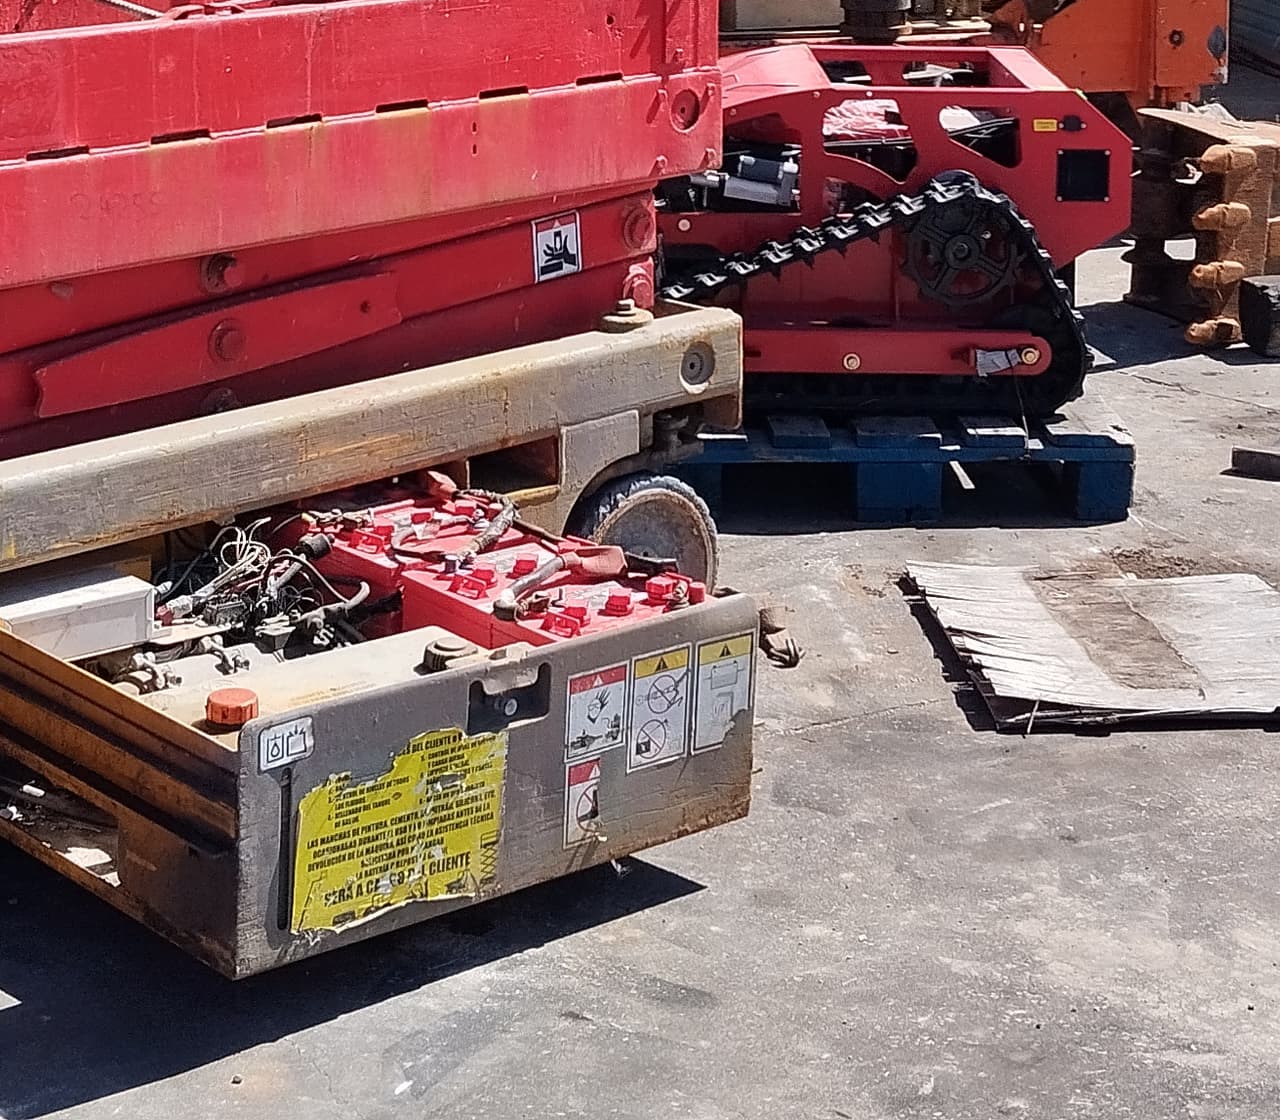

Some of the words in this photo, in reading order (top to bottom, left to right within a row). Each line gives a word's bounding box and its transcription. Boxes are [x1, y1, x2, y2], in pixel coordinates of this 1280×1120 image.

[425, 734, 452, 750] CLIENTE
[358, 831, 386, 846] DURANTE
[456, 806, 473, 819] ANTES
[474, 803, 482, 813] DE
[483, 801, 490, 810] LA
[307, 838, 318, 849] LAS
[320, 830, 351, 846] MANCHAS
[352, 827, 360, 837] DE
[308, 853, 346, 872] DEVOLUCIÓN
[348, 851, 356, 861] DE
[357, 848, 364, 858] LA
[426, 828, 434, 838] LA
[434, 818, 468, 835] ASISTENCIA
[470, 810, 494, 825] TÉCNICA
[397, 846, 409, 858] POR
[324, 884, 352, 907] SERÁ
[356, 884, 362, 898] A
[428, 851, 470, 876] CLIENTE
[364, 862, 389, 877] BATERÍA
